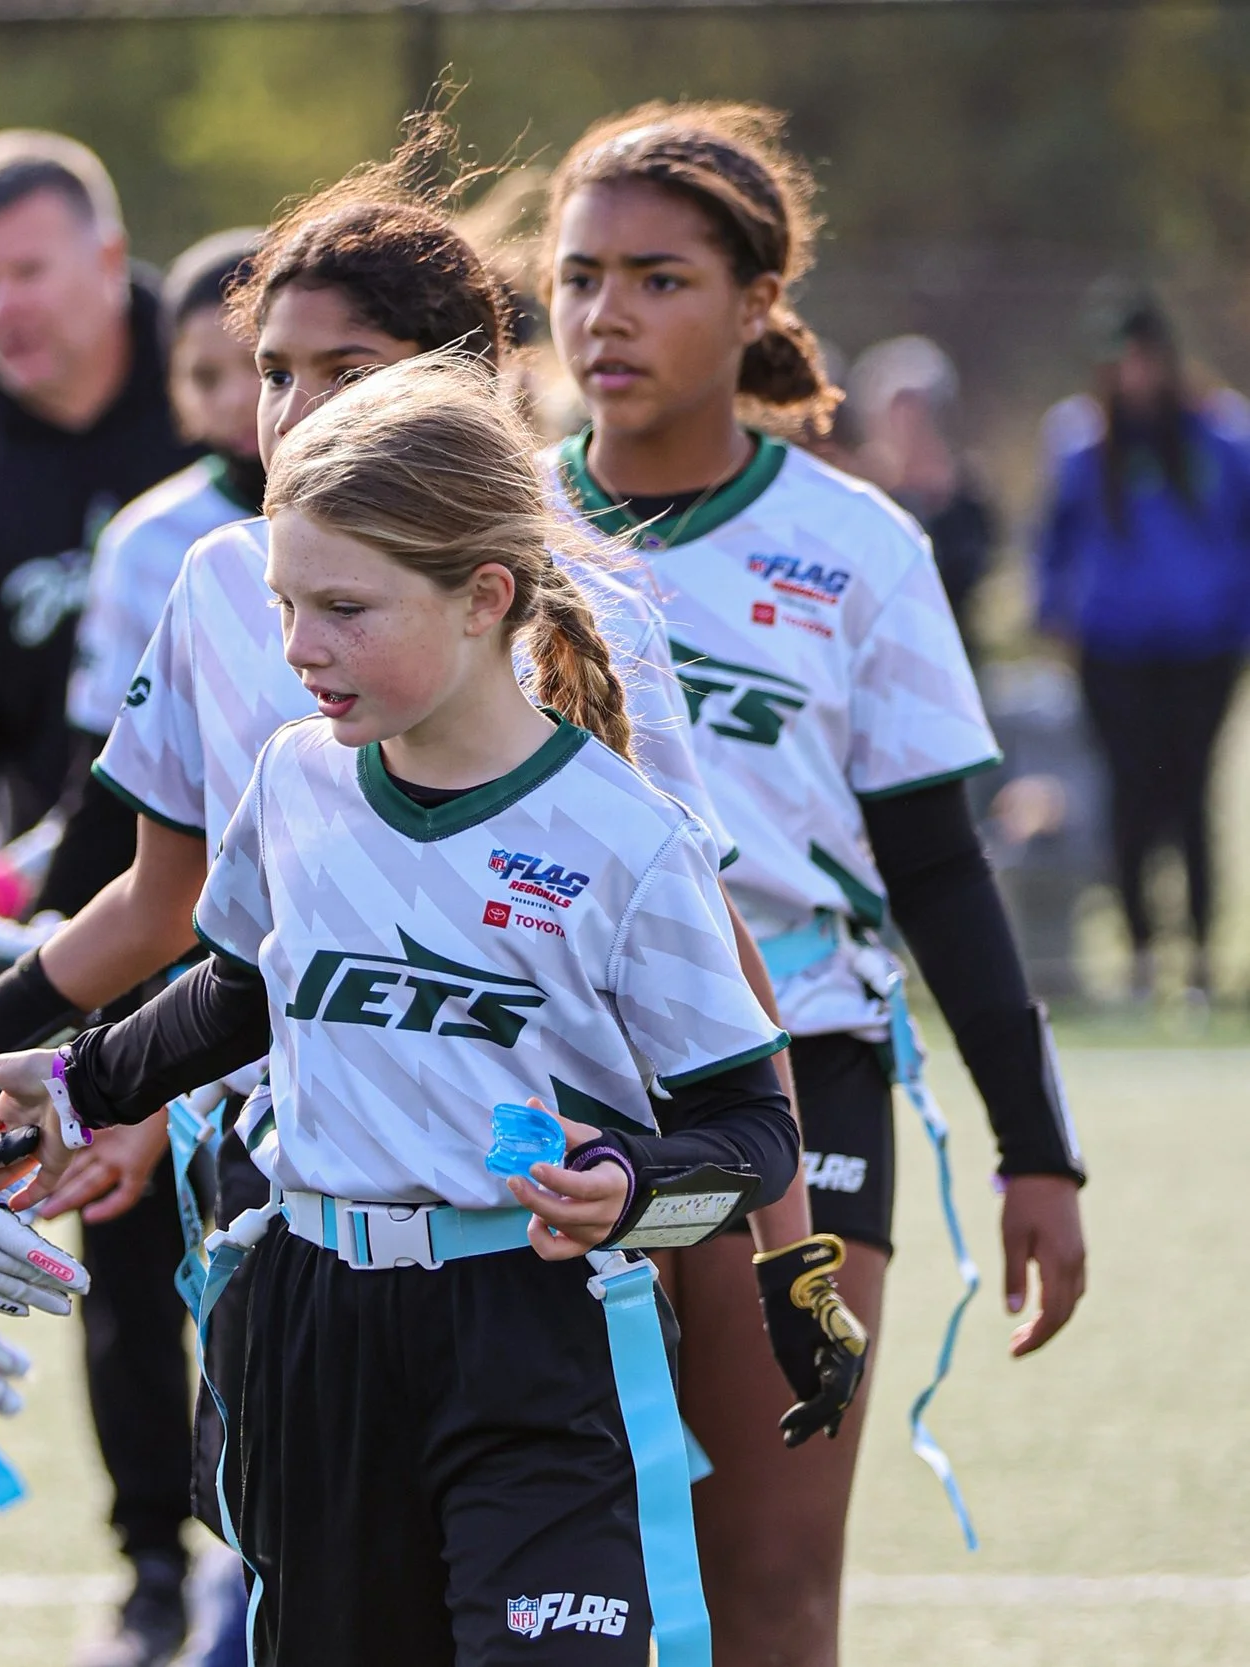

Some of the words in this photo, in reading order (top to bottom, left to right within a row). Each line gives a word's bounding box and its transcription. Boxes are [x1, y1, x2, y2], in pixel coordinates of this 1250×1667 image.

[499, 852, 590, 898] FLAG
[508, 880, 572, 909] REGIONALS
[285, 925, 550, 1049] JETS
[511, 1612, 535, 1628] NFL
[530, 1593, 630, 1639] FLAG
